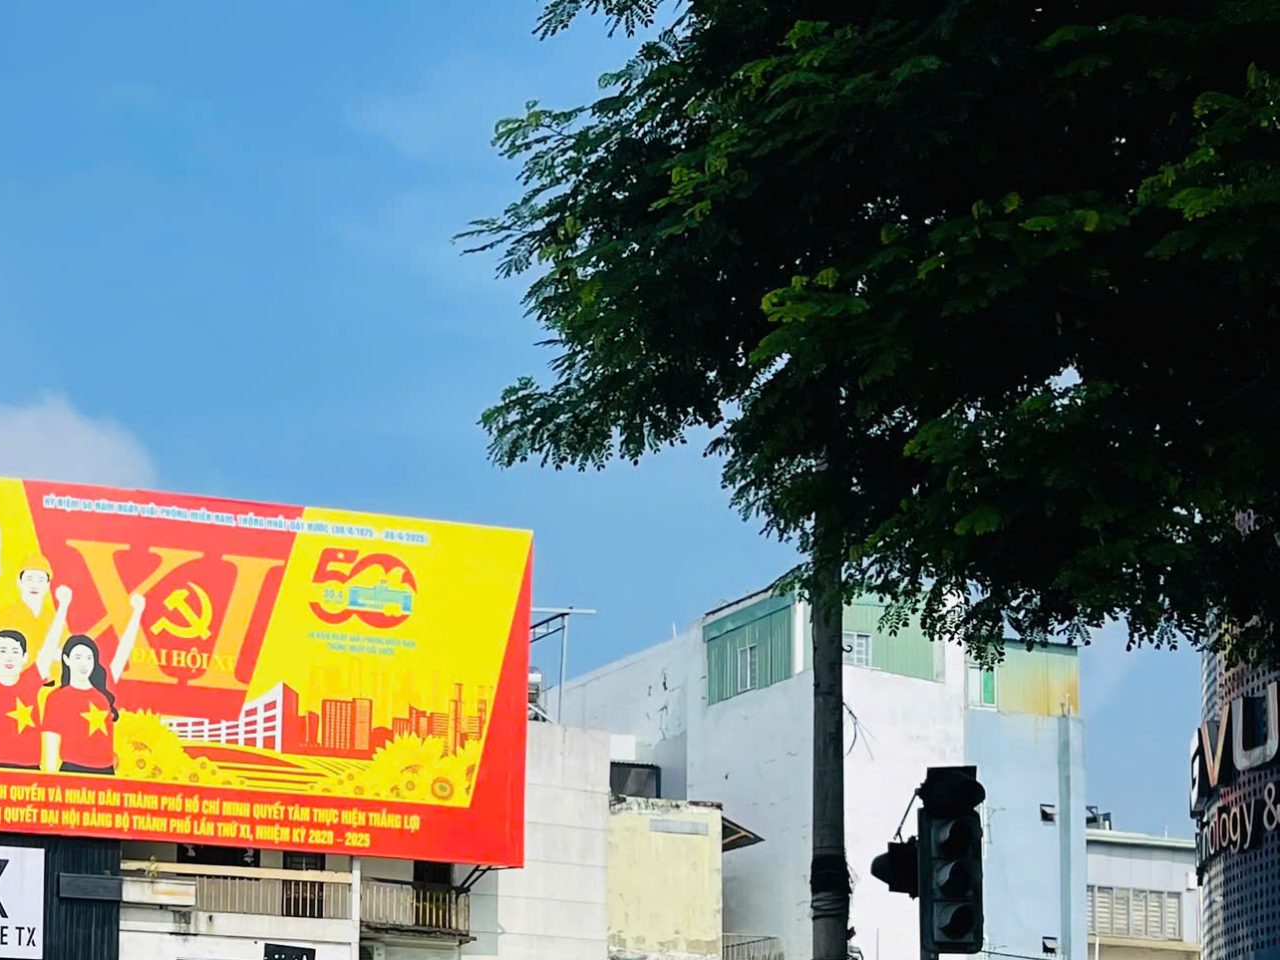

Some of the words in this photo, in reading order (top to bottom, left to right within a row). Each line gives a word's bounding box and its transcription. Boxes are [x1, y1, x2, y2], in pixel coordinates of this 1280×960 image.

[65, 539, 285, 690] XI
[172, 647, 208, 673] HỘI
[4, 804, 38, 824] QUYẾT
[41, 809, 59, 827] ĐẠI
[62, 808, 80, 828] HỘI
[83, 808, 112, 828] ĐẢNG
[115, 813, 130, 831] BỘ
[132, 812, 167, 832] THÀNH
[169, 815, 191, 834] PHỐ
[217, 820, 238, 838] THỨ
[240, 824, 253, 841] XI,
[256, 824, 291, 844] NHIỆM
[308, 829, 334, 845] 2020
[345, 832, 370, 847] 2025
[48, 784, 63, 803] VÀ
[65, 787, 95, 805] NHÂN
[98, 789, 120, 807] DÂN
[123, 790, 158, 810] THÀNH
[161, 793, 183, 812] PHỐ
[202, 796, 220, 815] CHÍ
[222, 801, 250, 817] MINH
[252, 801, 285, 820] QUYẾT
[288, 804, 310, 822] TÂM
[313, 808, 339, 826] THỰC
[341, 808, 366, 827] HIỆN
[368, 808, 401, 829] THẮNG
[15, 926, 37, 947] TX
